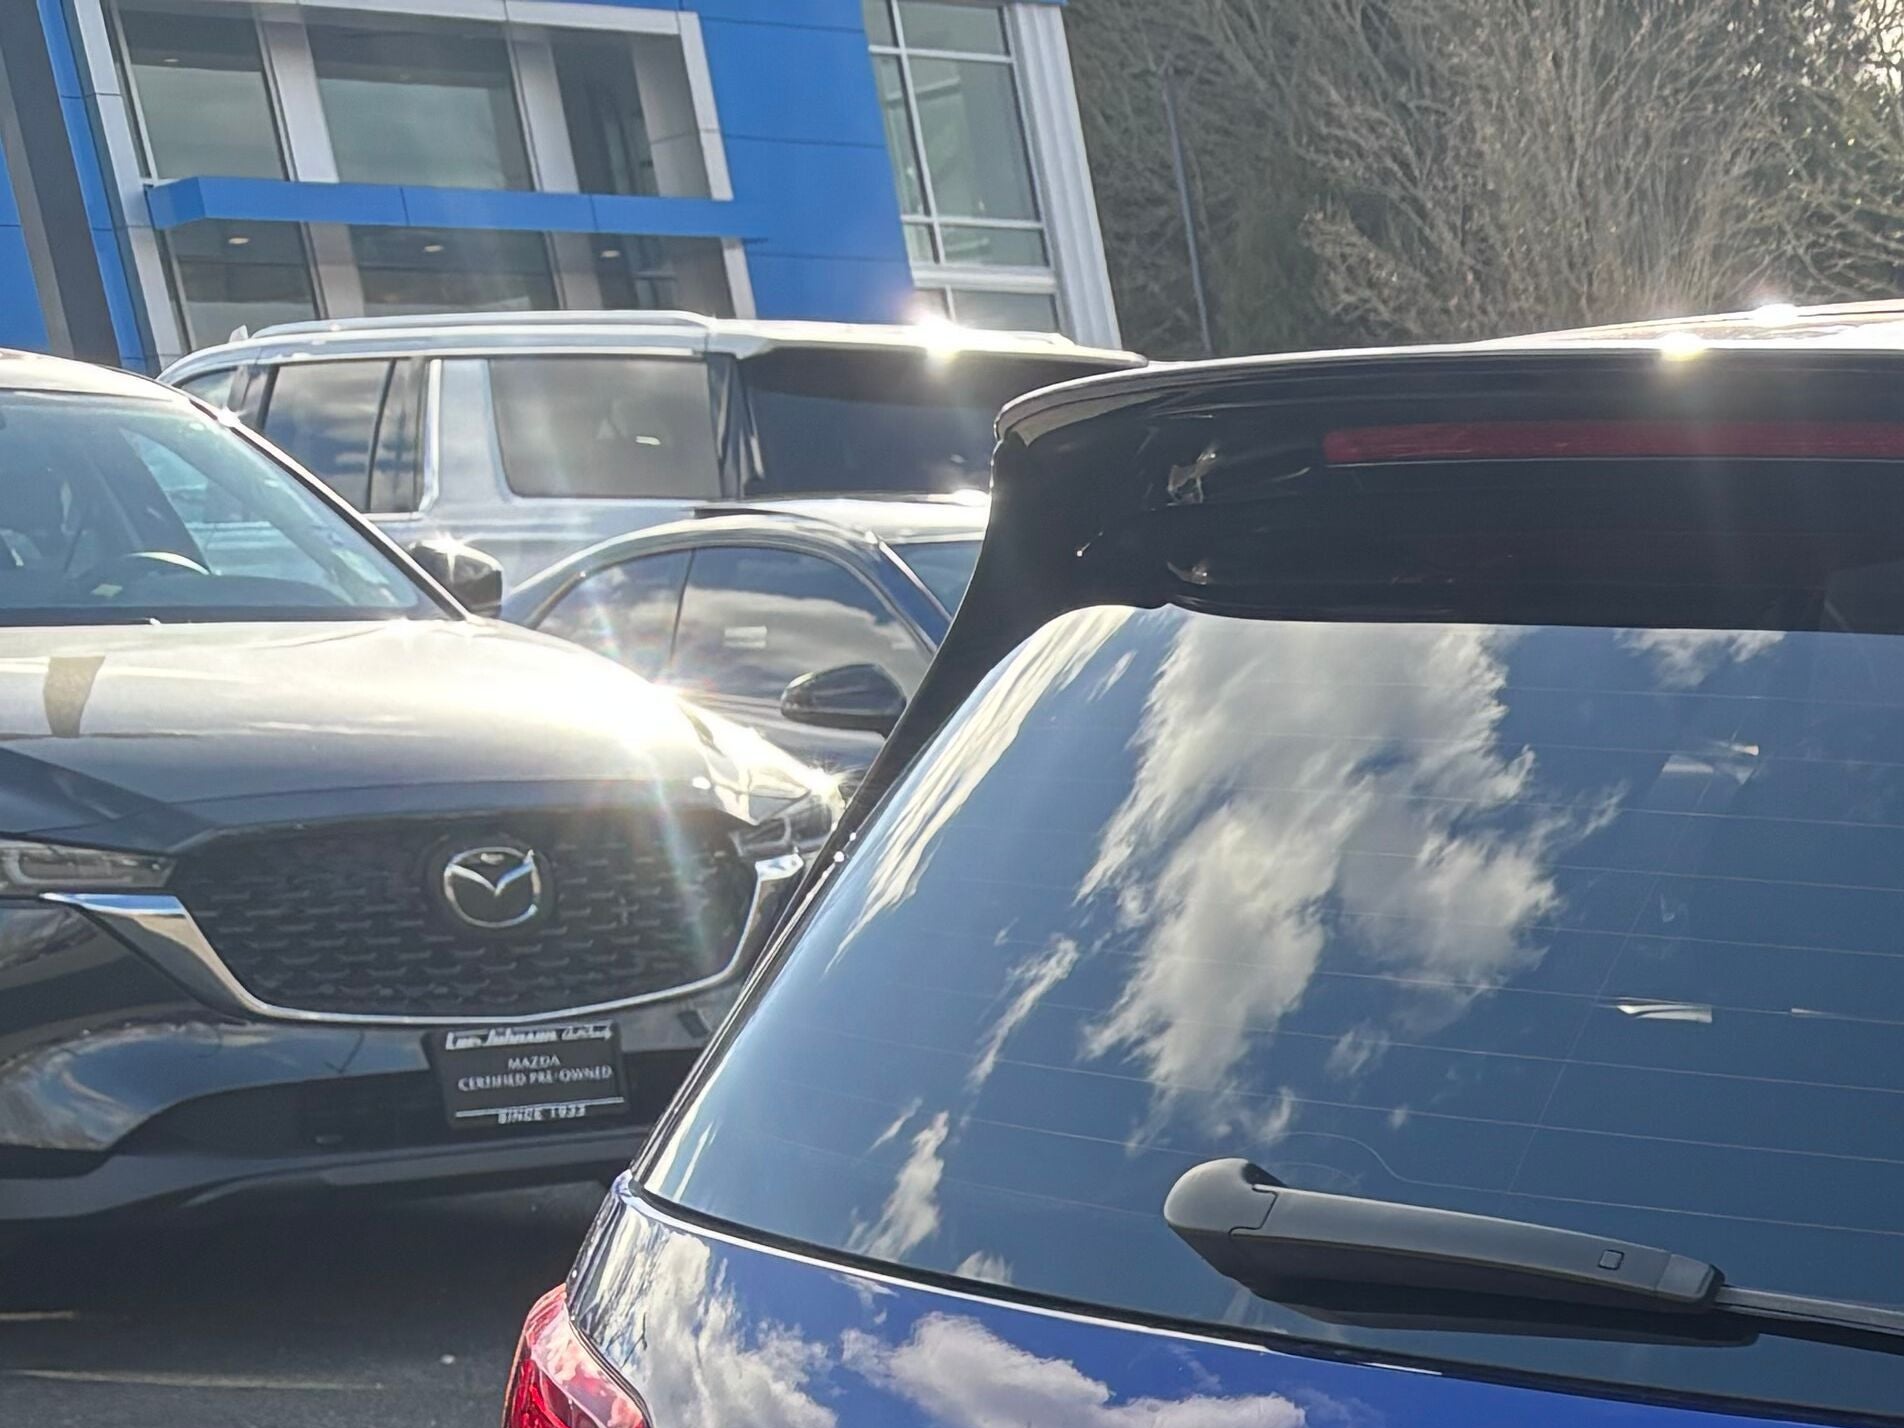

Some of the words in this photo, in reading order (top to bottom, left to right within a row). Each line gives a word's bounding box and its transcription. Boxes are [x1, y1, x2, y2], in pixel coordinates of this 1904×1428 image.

[508, 1054, 561, 1070] MAZDA
[457, 1072, 526, 1092] CERTIFIED
[529, 1064, 613, 1084] PRE-OWNED
